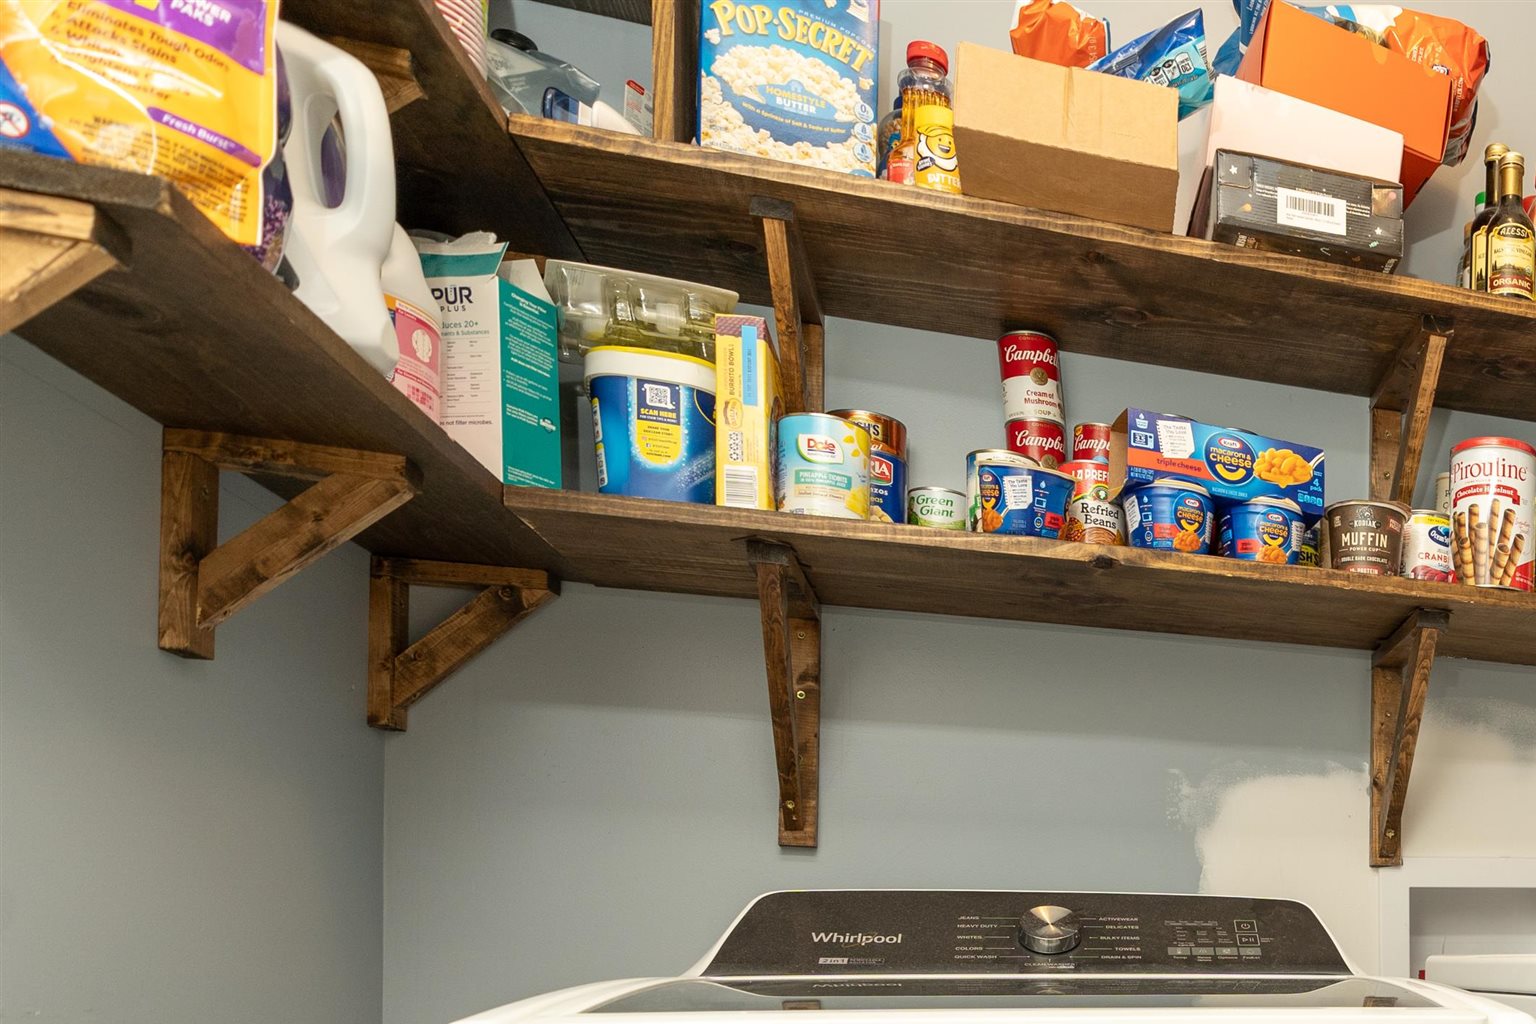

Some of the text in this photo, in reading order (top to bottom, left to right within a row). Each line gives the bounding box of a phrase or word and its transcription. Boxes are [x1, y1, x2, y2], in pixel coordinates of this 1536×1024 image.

[149, 27, 192, 53] Tough
[776, 96, 817, 115] BUTTER
[161, 113, 197, 136] Fresh
[1500, 226, 1528, 239] ALESSI
[1492, 277, 1532, 291] ORGANIC
[1004, 344, 1059, 367] Campbell
[1026, 389, 1047, 398] Cream
[1024, 397, 1057, 408] Mushroom
[640, 407, 658, 416] SCAN
[659, 409, 677, 419] HERE
[807, 438, 836, 450] Dole
[1222, 439, 1239, 448] Kraft
[1210, 446, 1246, 459] macaroni
[1156, 458, 1202, 473] triple cheese
[1452, 458, 1528, 482] Pirouline
[1313, 478, 1319, 486] 4
[1309, 485, 1322, 493] pack
[1457, 486, 1484, 498] Chocolate
[916, 494, 954, 506] Green
[919, 504, 955, 519] Giant
[1081, 502, 1119, 520] Refried
[1084, 513, 1117, 530] Beans
[1353, 519, 1377, 529] KODIAK
[1341, 532, 1389, 548] MUFFIN
[1418, 551, 1449, 562] CRANB
[812, 932, 902, 946] Whirlpool
